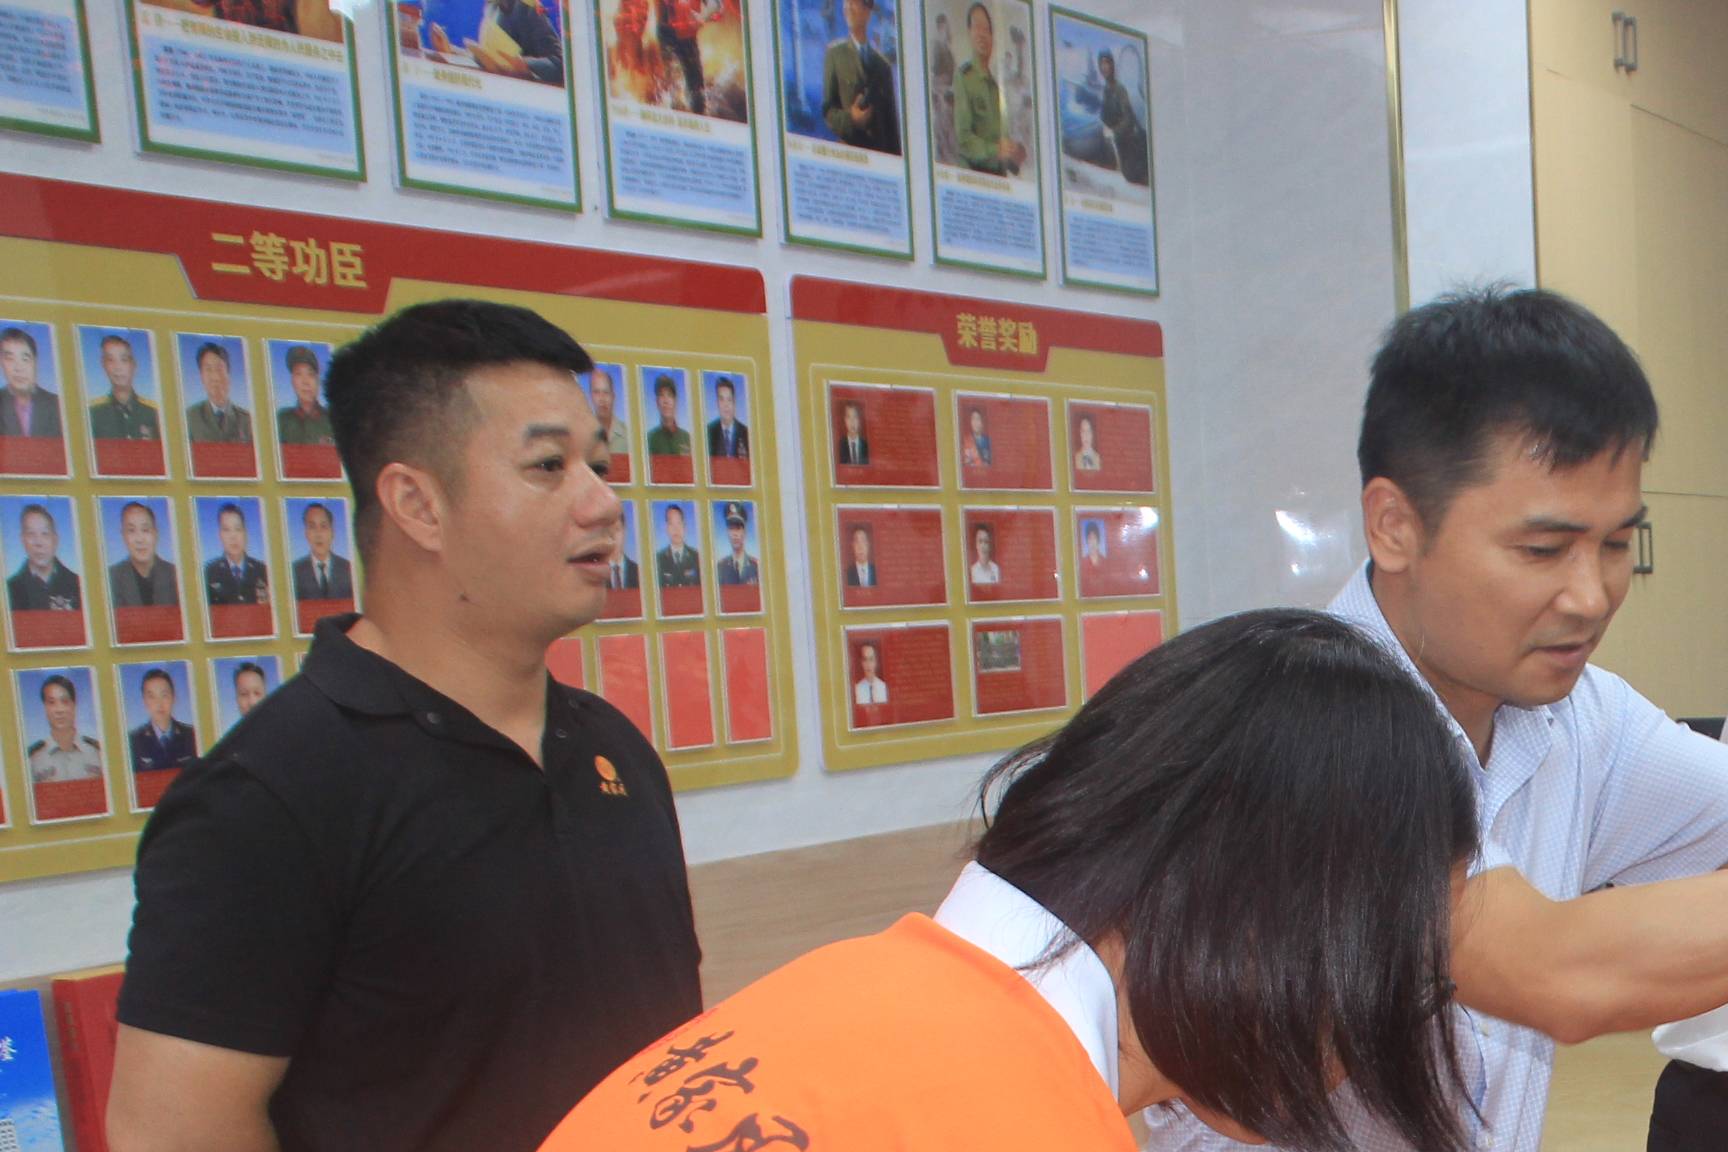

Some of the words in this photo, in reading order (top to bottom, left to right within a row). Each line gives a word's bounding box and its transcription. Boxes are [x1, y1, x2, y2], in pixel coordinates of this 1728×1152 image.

[211, 232, 367, 290] 二等功臣
[956, 312, 1038, 354] 荣誉奖励
